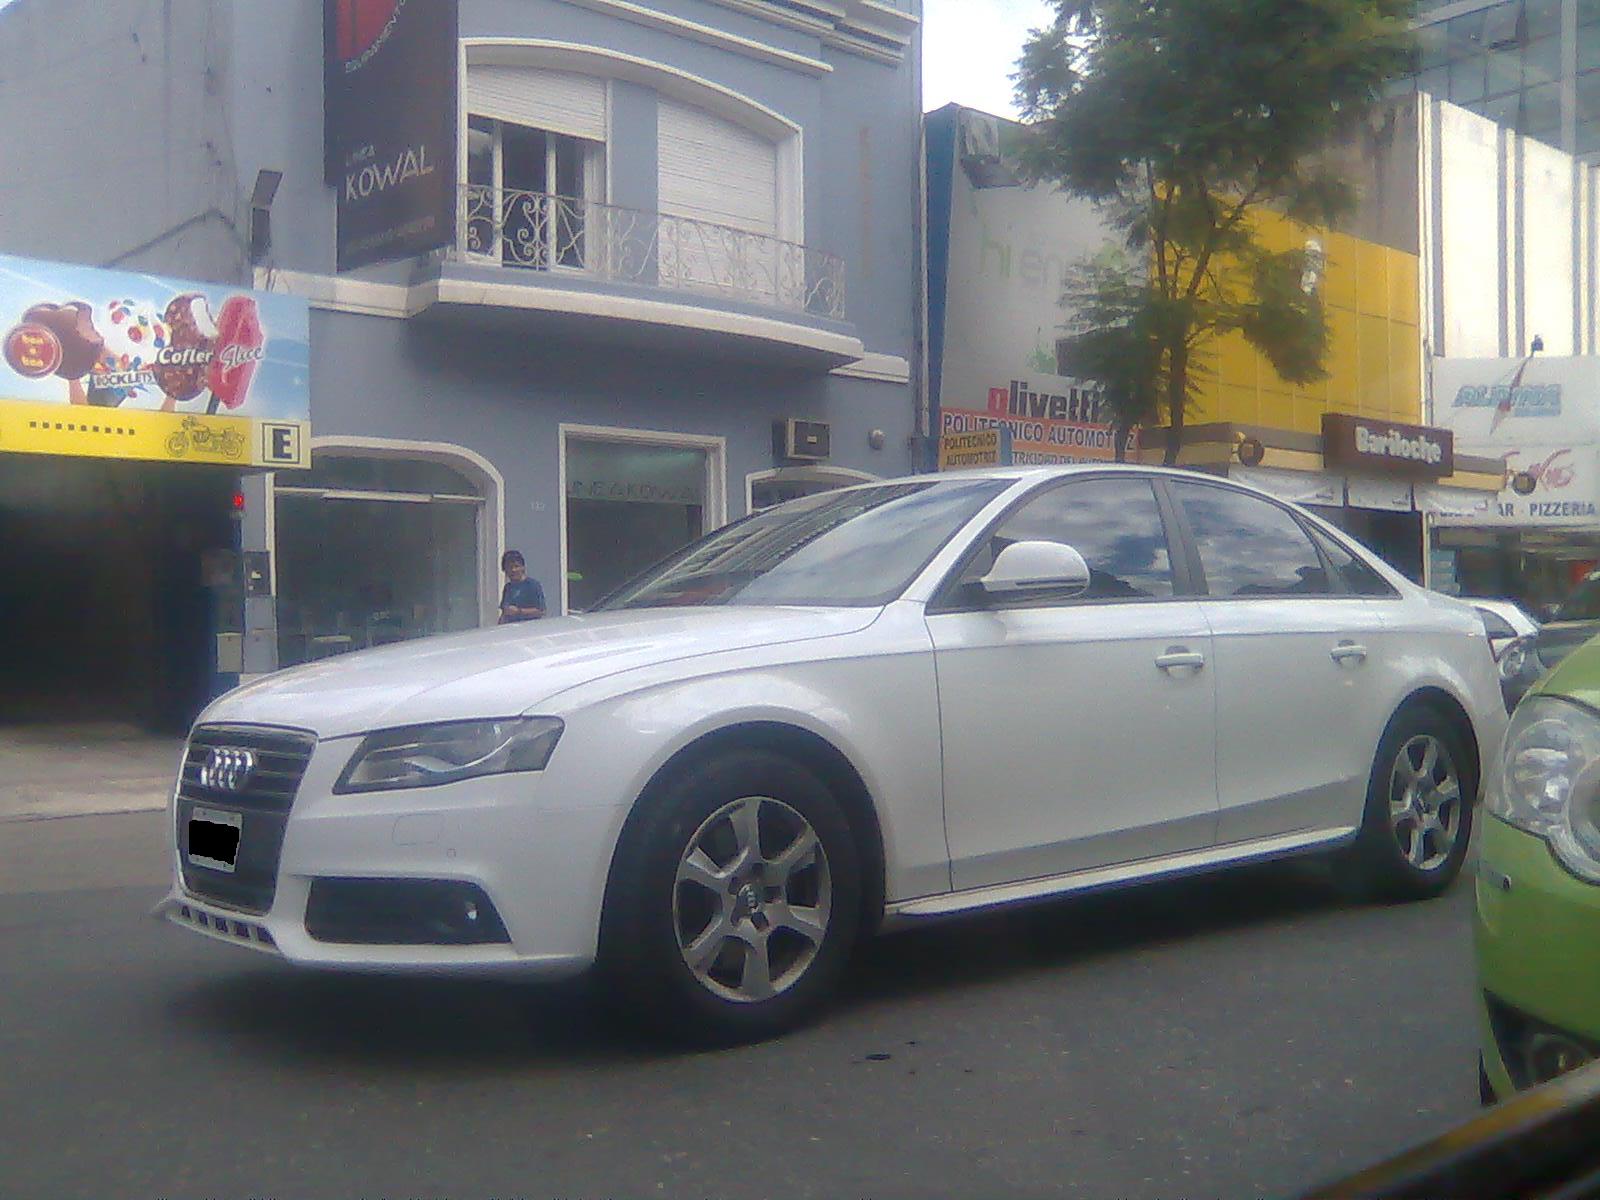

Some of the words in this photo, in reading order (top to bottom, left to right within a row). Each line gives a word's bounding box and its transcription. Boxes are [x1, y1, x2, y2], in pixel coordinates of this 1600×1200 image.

[345, 143, 434, 201] KOWAL
[158, 347, 214, 366] Cofler
[272, 429, 292, 459] E
[1354, 426, 1442, 464] Bariloche
[1529, 502, 1596, 517] PIZZERIA
